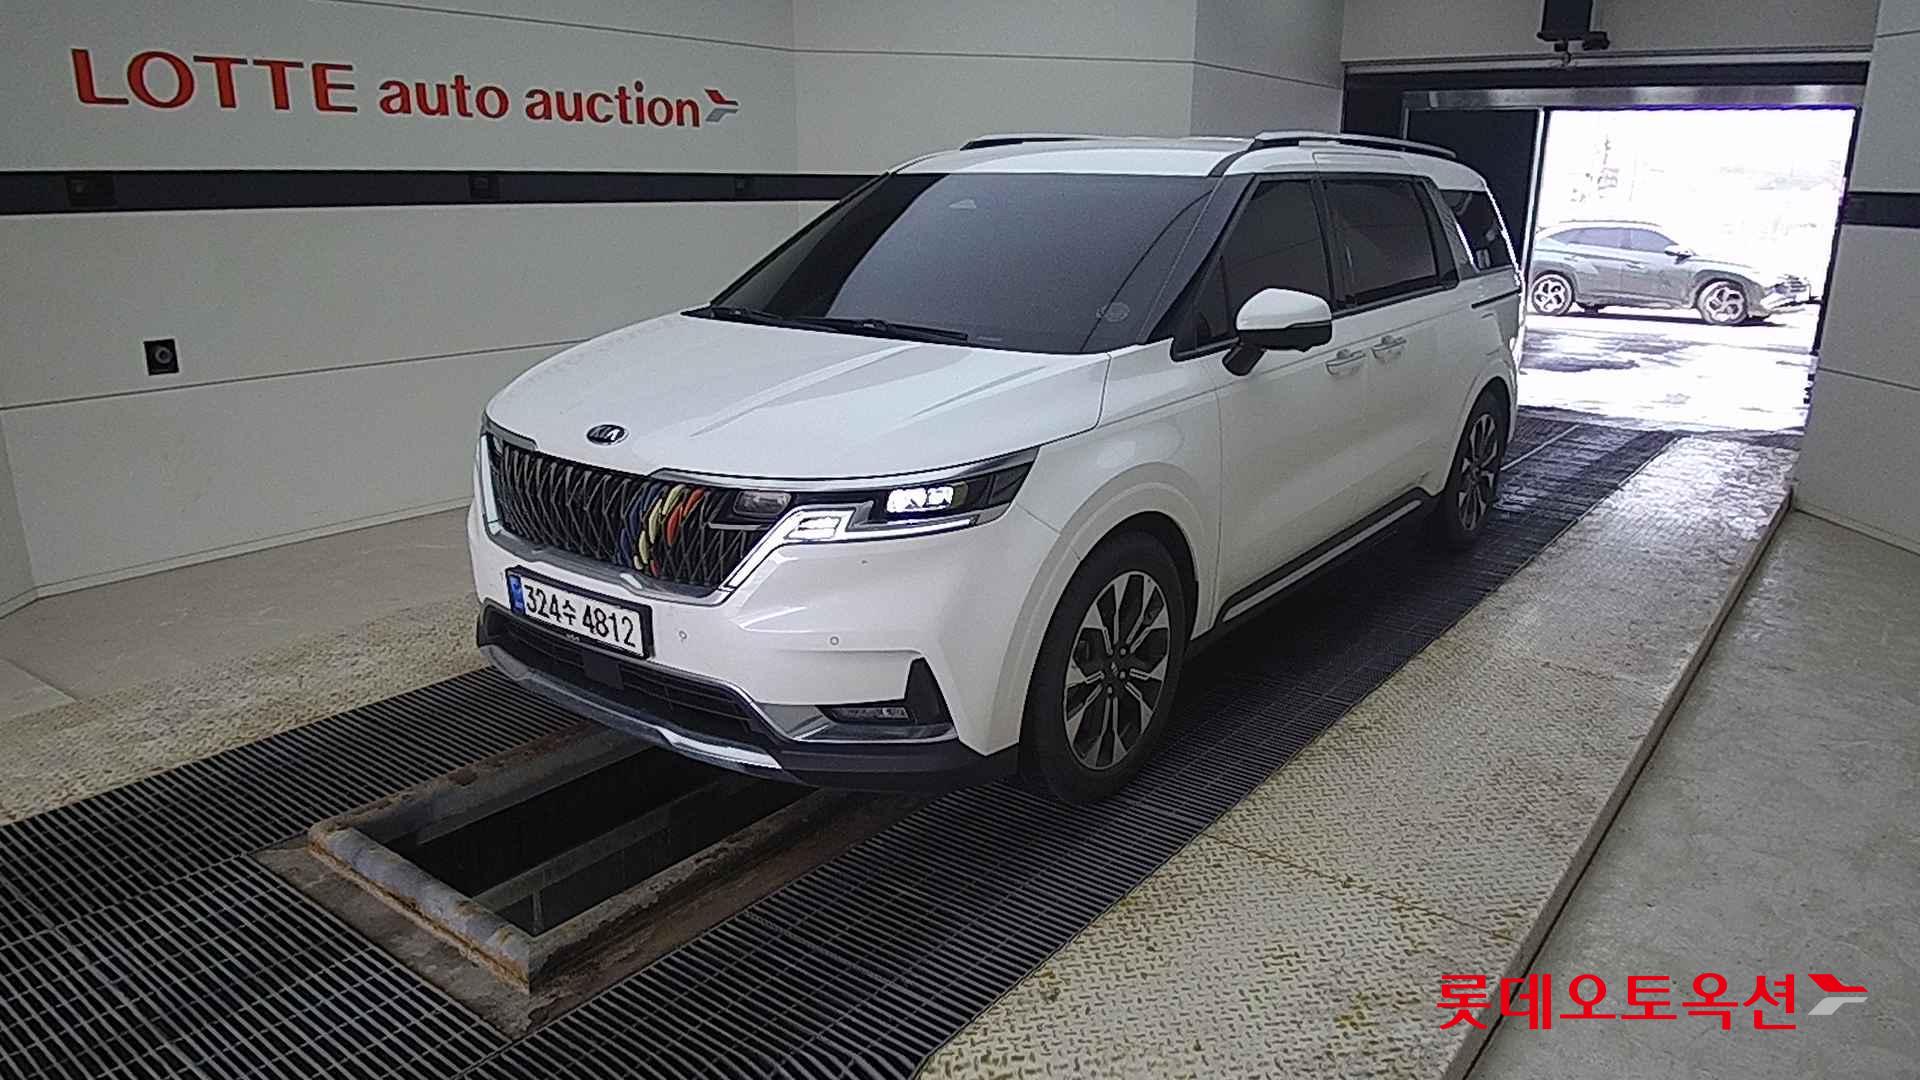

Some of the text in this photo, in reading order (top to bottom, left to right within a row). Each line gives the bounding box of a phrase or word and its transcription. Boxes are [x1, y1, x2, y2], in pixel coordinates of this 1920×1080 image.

[70, 48, 700, 127] LOTTE auto auction
[583, 605, 635, 647] 4812
